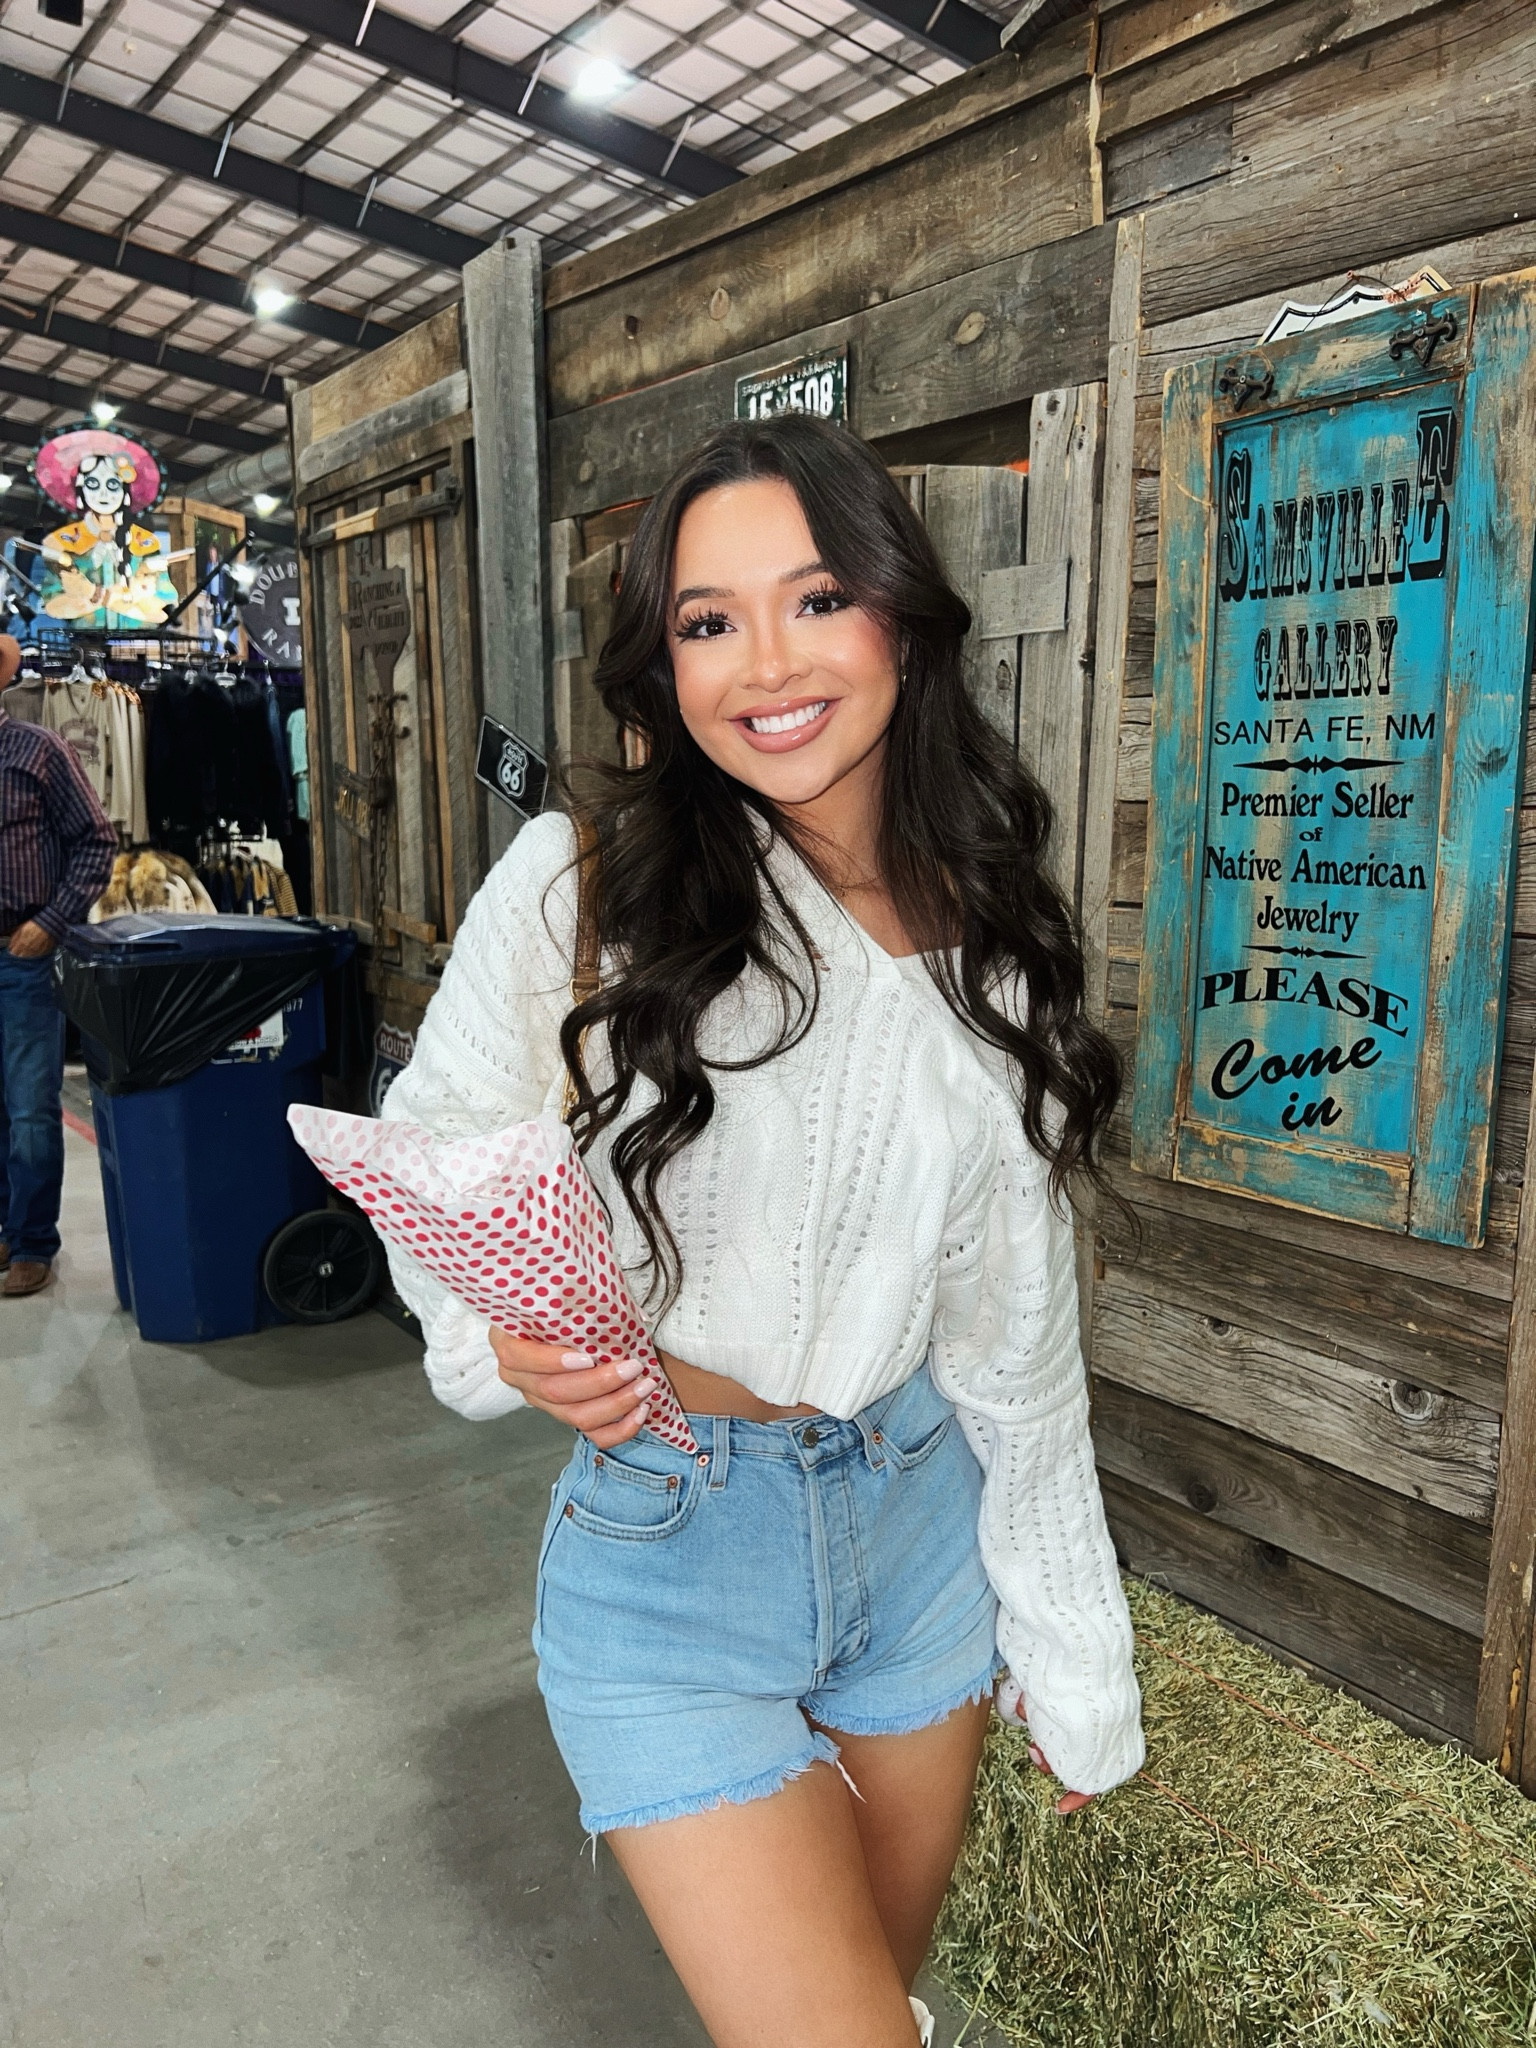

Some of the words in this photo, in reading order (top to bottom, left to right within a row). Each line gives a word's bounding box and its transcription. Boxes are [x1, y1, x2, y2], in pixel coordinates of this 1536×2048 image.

[249, 561, 299, 605] DOUB
[1254, 616, 1398, 701] GALLERY
[1213, 717, 1315, 746] SANTA
[1326, 715, 1372, 745] FE,
[1384, 712, 1436, 740] NM
[501, 762, 521, 791] 66
[1220, 781, 1323, 818] Premier
[1331, 781, 1415, 819] Seller
[1299, 826, 1324, 842] of
[1204, 846, 1283, 884] Native
[1290, 848, 1427, 890] American
[1256, 895, 1360, 942] Jewelry
[1200, 966, 1410, 1039] PLEASE
[380, 1033, 412, 1062] ROUTE
[1210, 1035, 1384, 1101] Come
[1280, 1090, 1343, 1132] in
